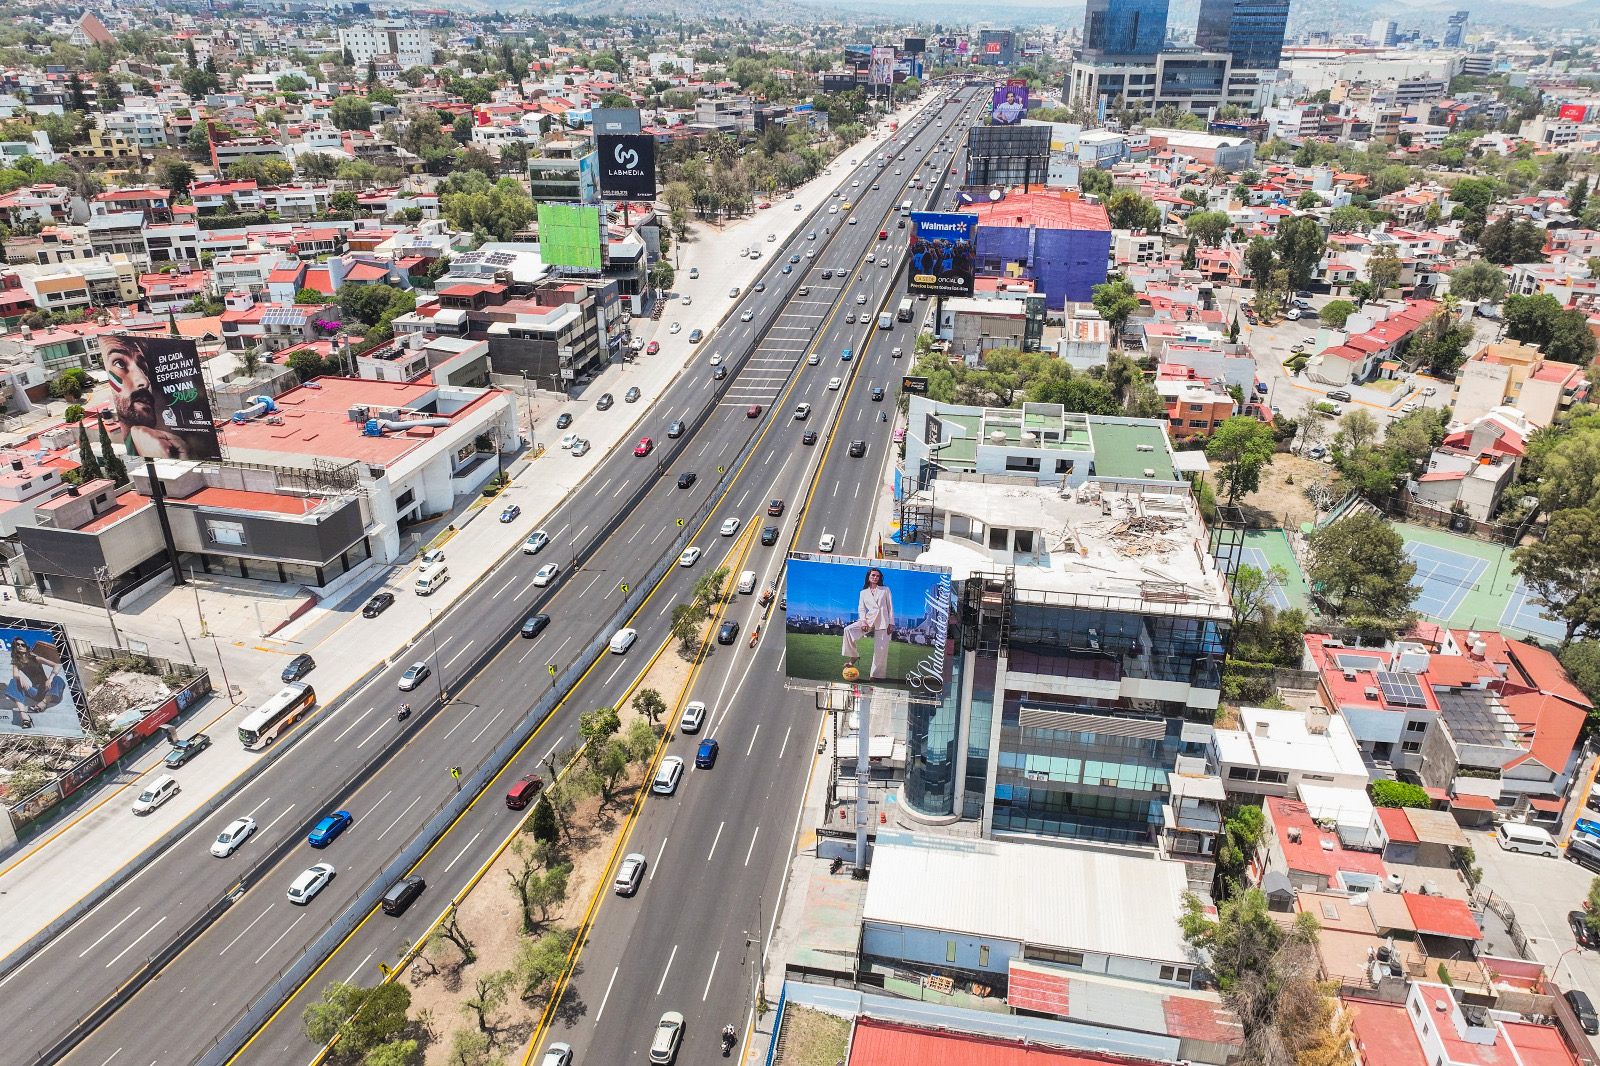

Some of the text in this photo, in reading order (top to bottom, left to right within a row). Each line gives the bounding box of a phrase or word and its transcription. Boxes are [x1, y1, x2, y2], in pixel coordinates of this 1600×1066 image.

[921, 222, 956, 231] Walmart
[159, 352, 183, 363] EN CADA
[155, 358, 194, 373] SÚPLICA HAY
[157, 368, 200, 382] ESPERANZA.
[163, 381, 194, 394] NO VAN
[931, 616, 949, 633] de
[917, 633, 946, 693] Palacio
[906, 670, 921, 688] El
